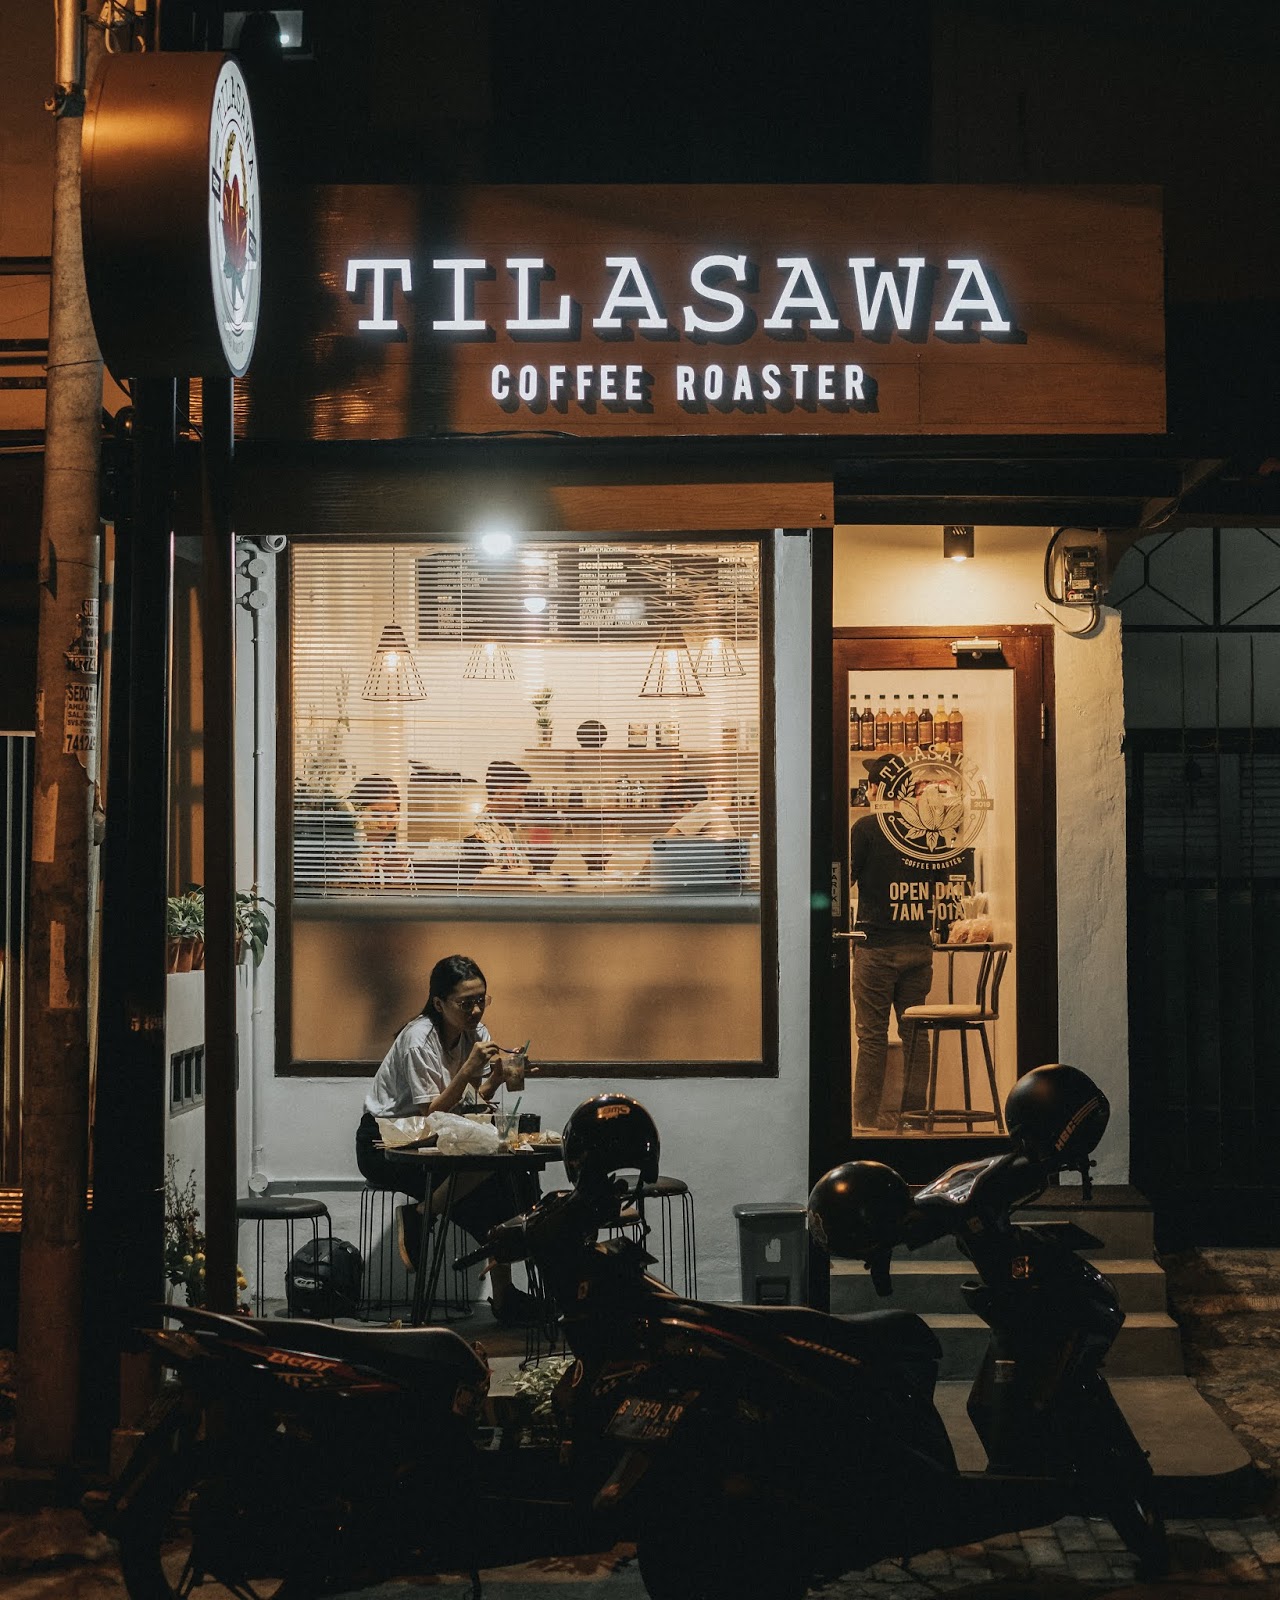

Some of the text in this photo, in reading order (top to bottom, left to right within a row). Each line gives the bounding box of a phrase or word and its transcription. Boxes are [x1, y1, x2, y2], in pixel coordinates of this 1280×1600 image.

[345, 254, 1011, 333] TILASAWA
[491, 364, 866, 401] COFFEE ROASTER
[879, 744, 980, 782] TILASAWA
[831, 866, 839, 902] TARIK
[889, 882, 930, 901] OPEN
[890, 902, 925, 921] 7AM
